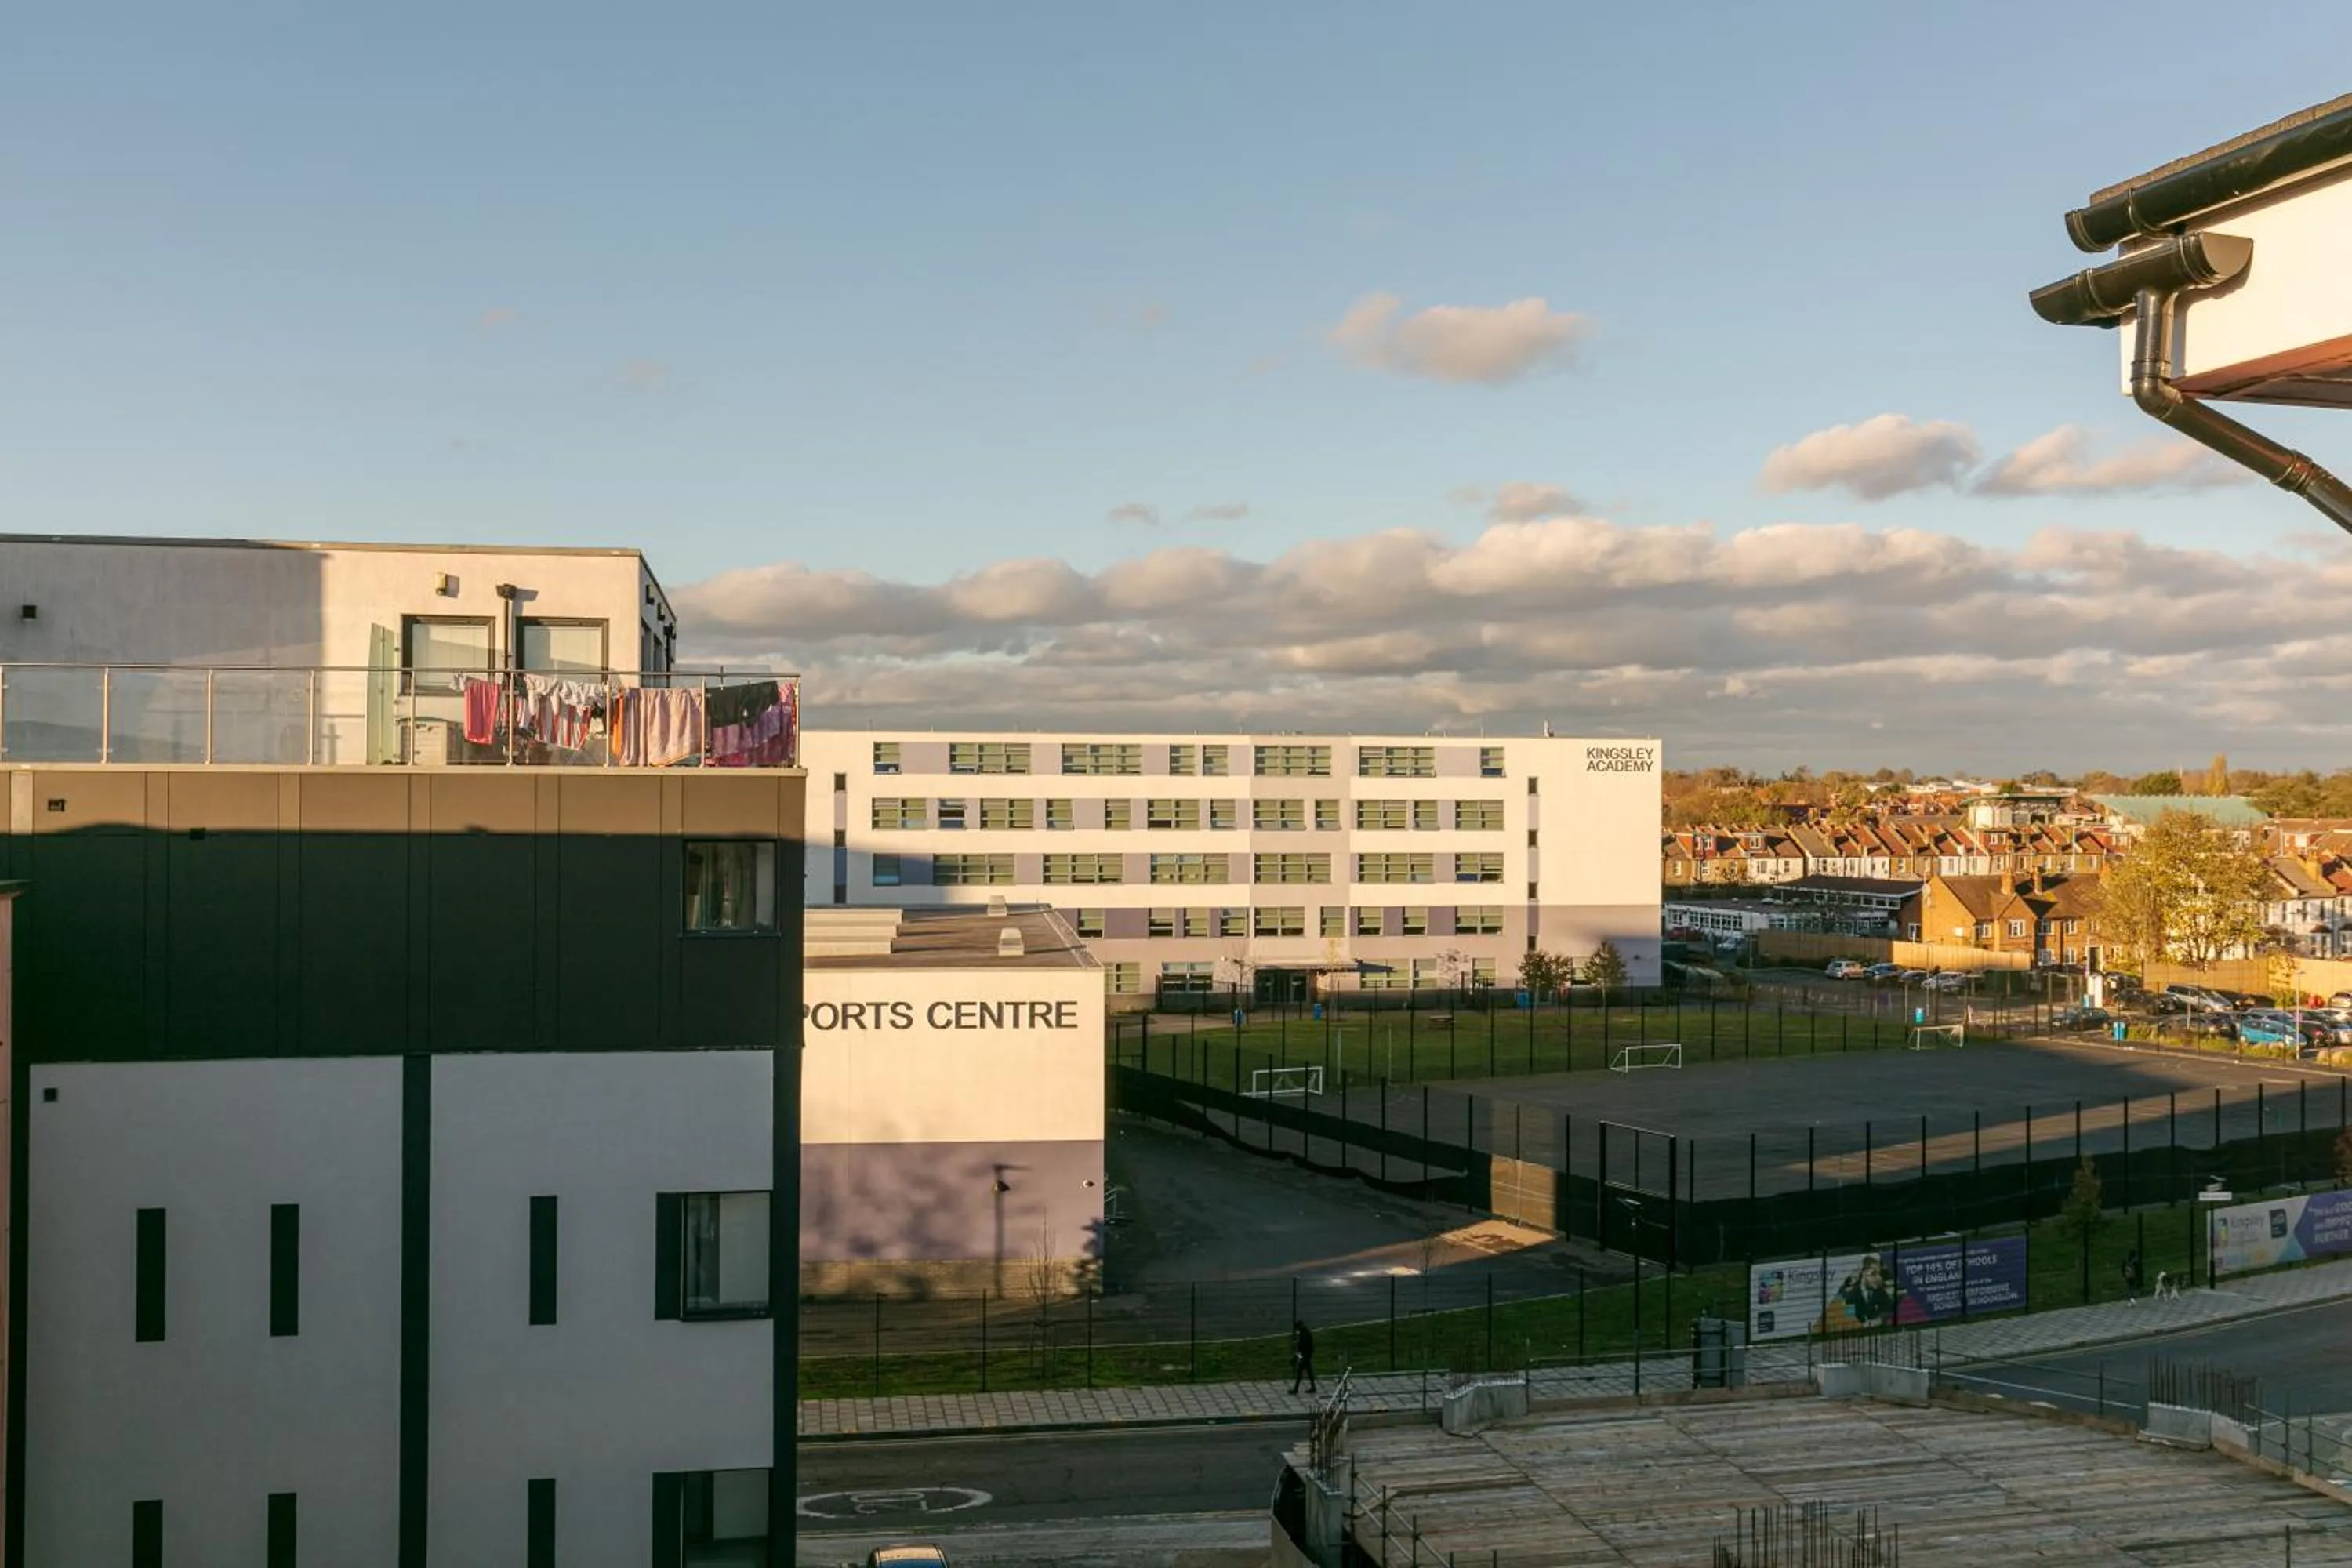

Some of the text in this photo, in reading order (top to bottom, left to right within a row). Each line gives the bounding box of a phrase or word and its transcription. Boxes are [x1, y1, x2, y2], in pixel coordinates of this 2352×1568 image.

[1586, 747, 1653, 759] KINGSLEY
[1586, 760, 1653, 772] ACADEMY
[926, 1000, 1078, 1030] CENTRE
